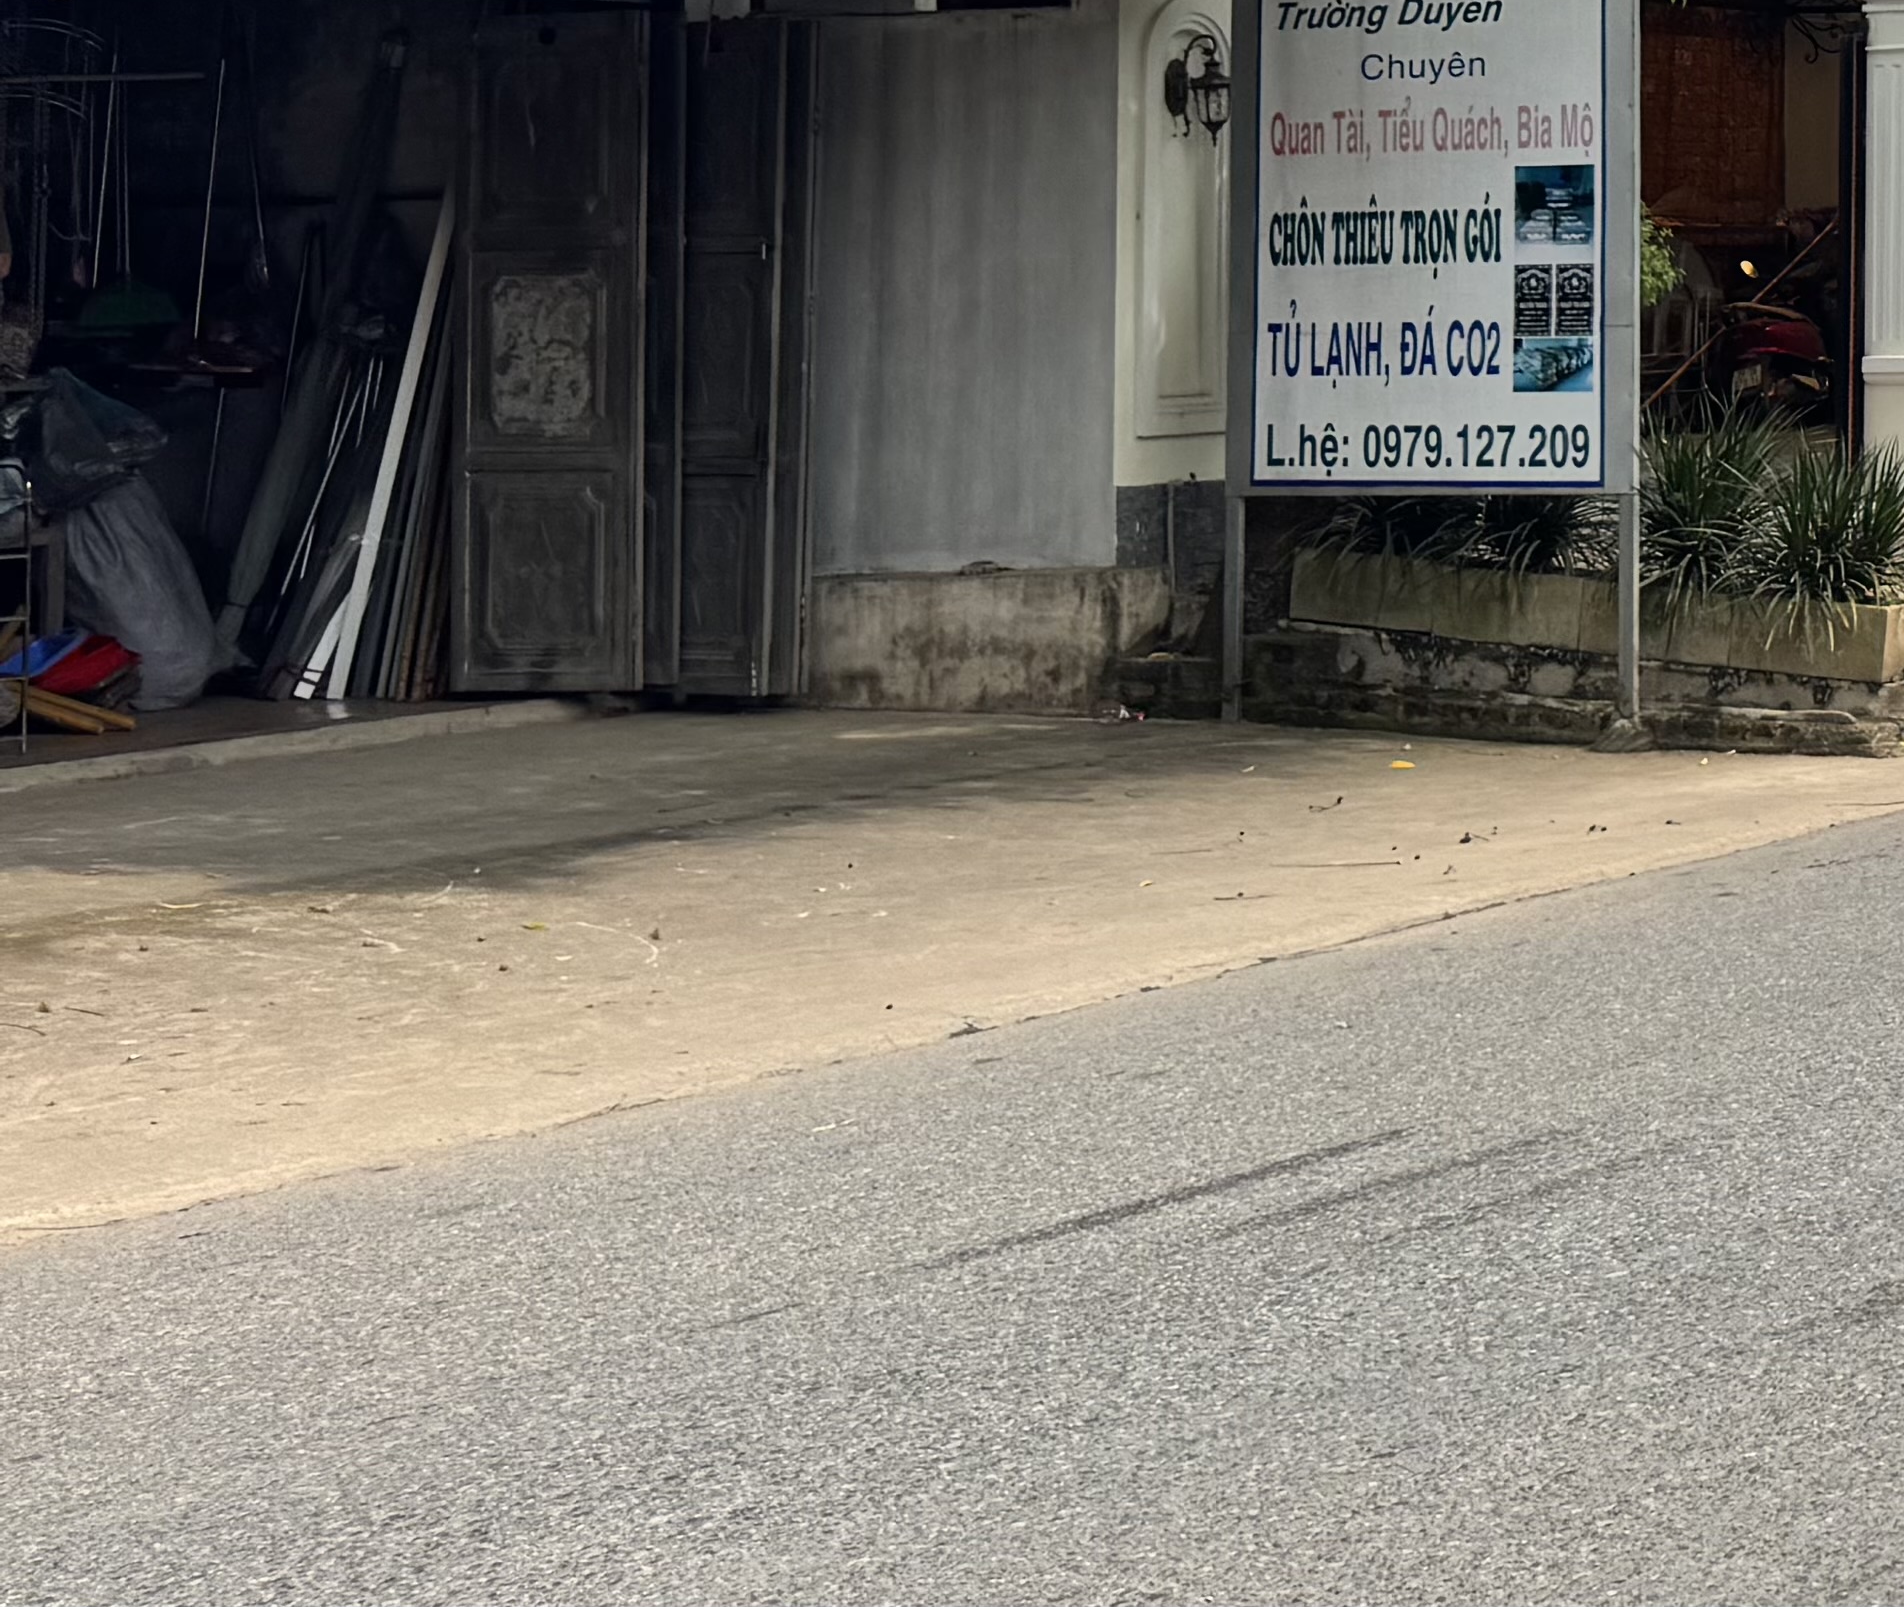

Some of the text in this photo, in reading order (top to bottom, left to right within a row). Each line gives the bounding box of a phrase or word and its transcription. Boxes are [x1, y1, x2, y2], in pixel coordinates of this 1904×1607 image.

[1360, 51, 1486, 85] Chuyên
[1270, 95, 1594, 162] Quan Tài, Tiểu Quách, Bia Mộ
[1269, 191, 1502, 280] CHÔN THIÊU TRỌN GÓI
[1267, 299, 1301, 377] TỦ
[1310, 321, 1390, 389] LẠNH,
[1399, 304, 1437, 376] ĐÁ
[1446, 319, 1501, 377] CO2
[1266, 422, 1590, 477] L.hệ: 0979.127.209
